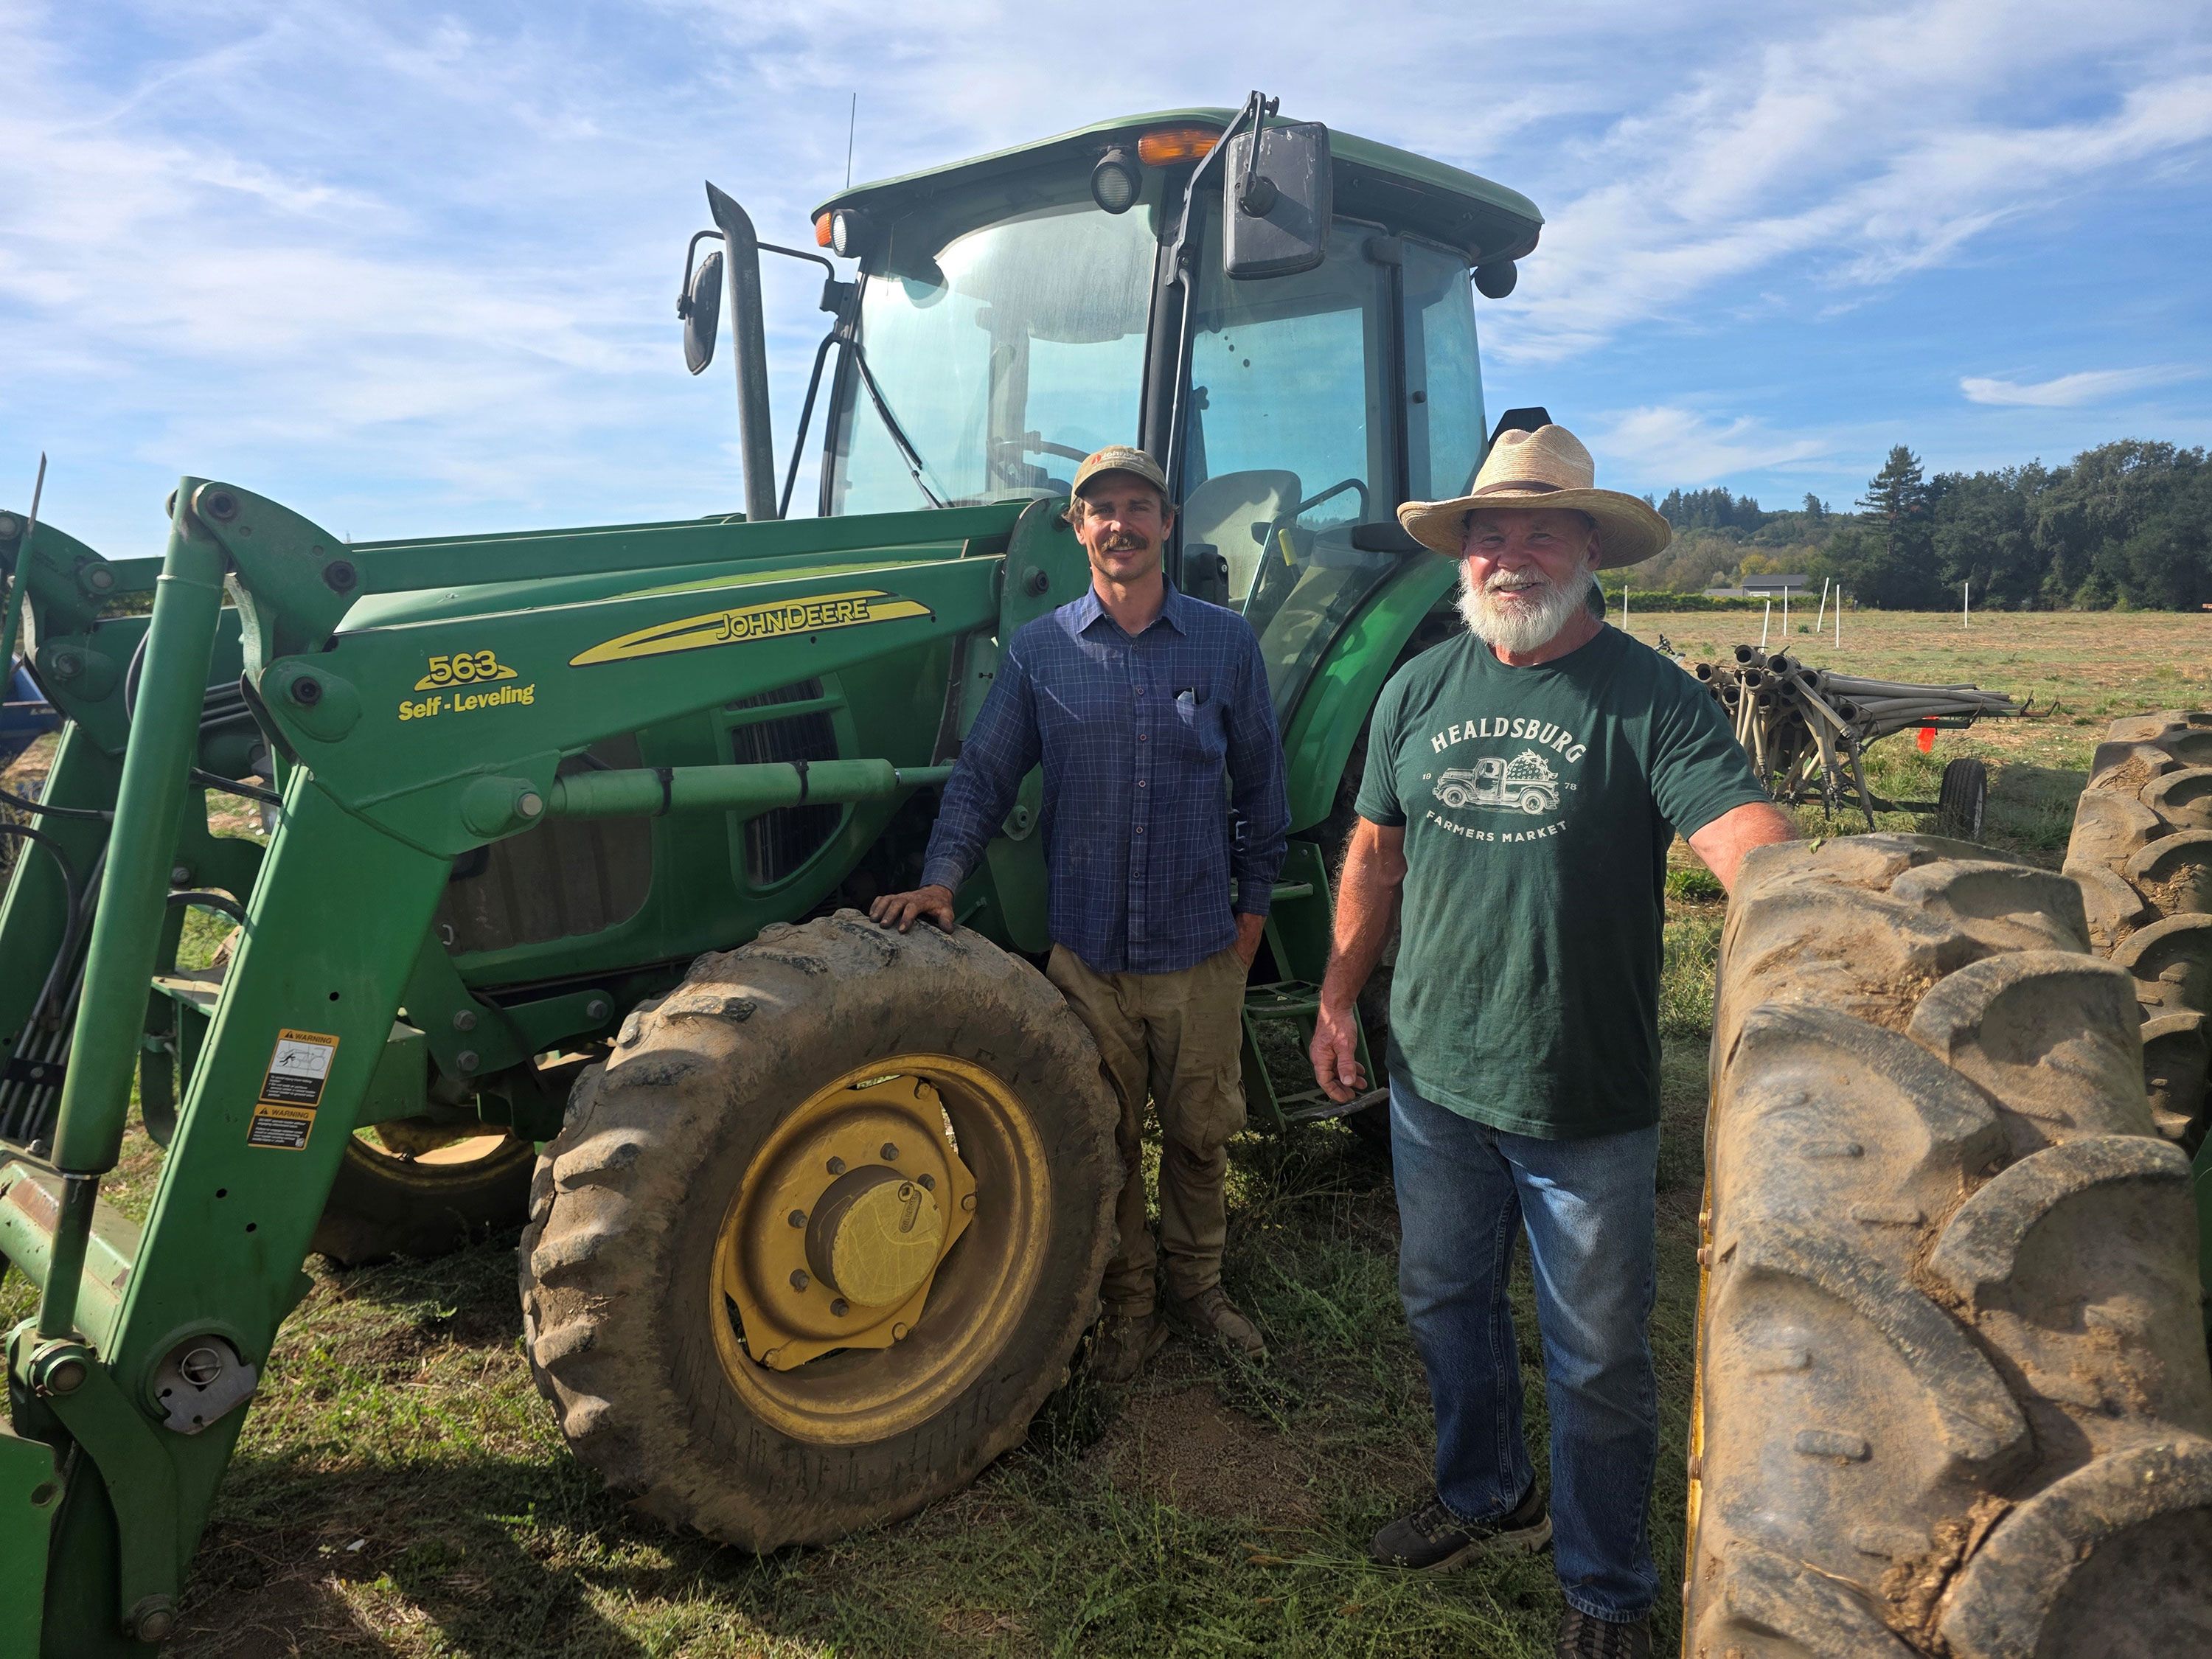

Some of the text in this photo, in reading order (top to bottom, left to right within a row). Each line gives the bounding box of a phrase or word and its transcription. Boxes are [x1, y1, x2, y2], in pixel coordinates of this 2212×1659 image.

[428, 650, 498, 684] 563
[1431, 717, 1586, 763] HEALDSBURG
[1565, 782, 1577, 790] 78
[1426, 810, 1568, 842] FARMERS MARKET
[295, 1033, 332, 1044] WARNING
[271, 1108, 310, 1119] WARNING
